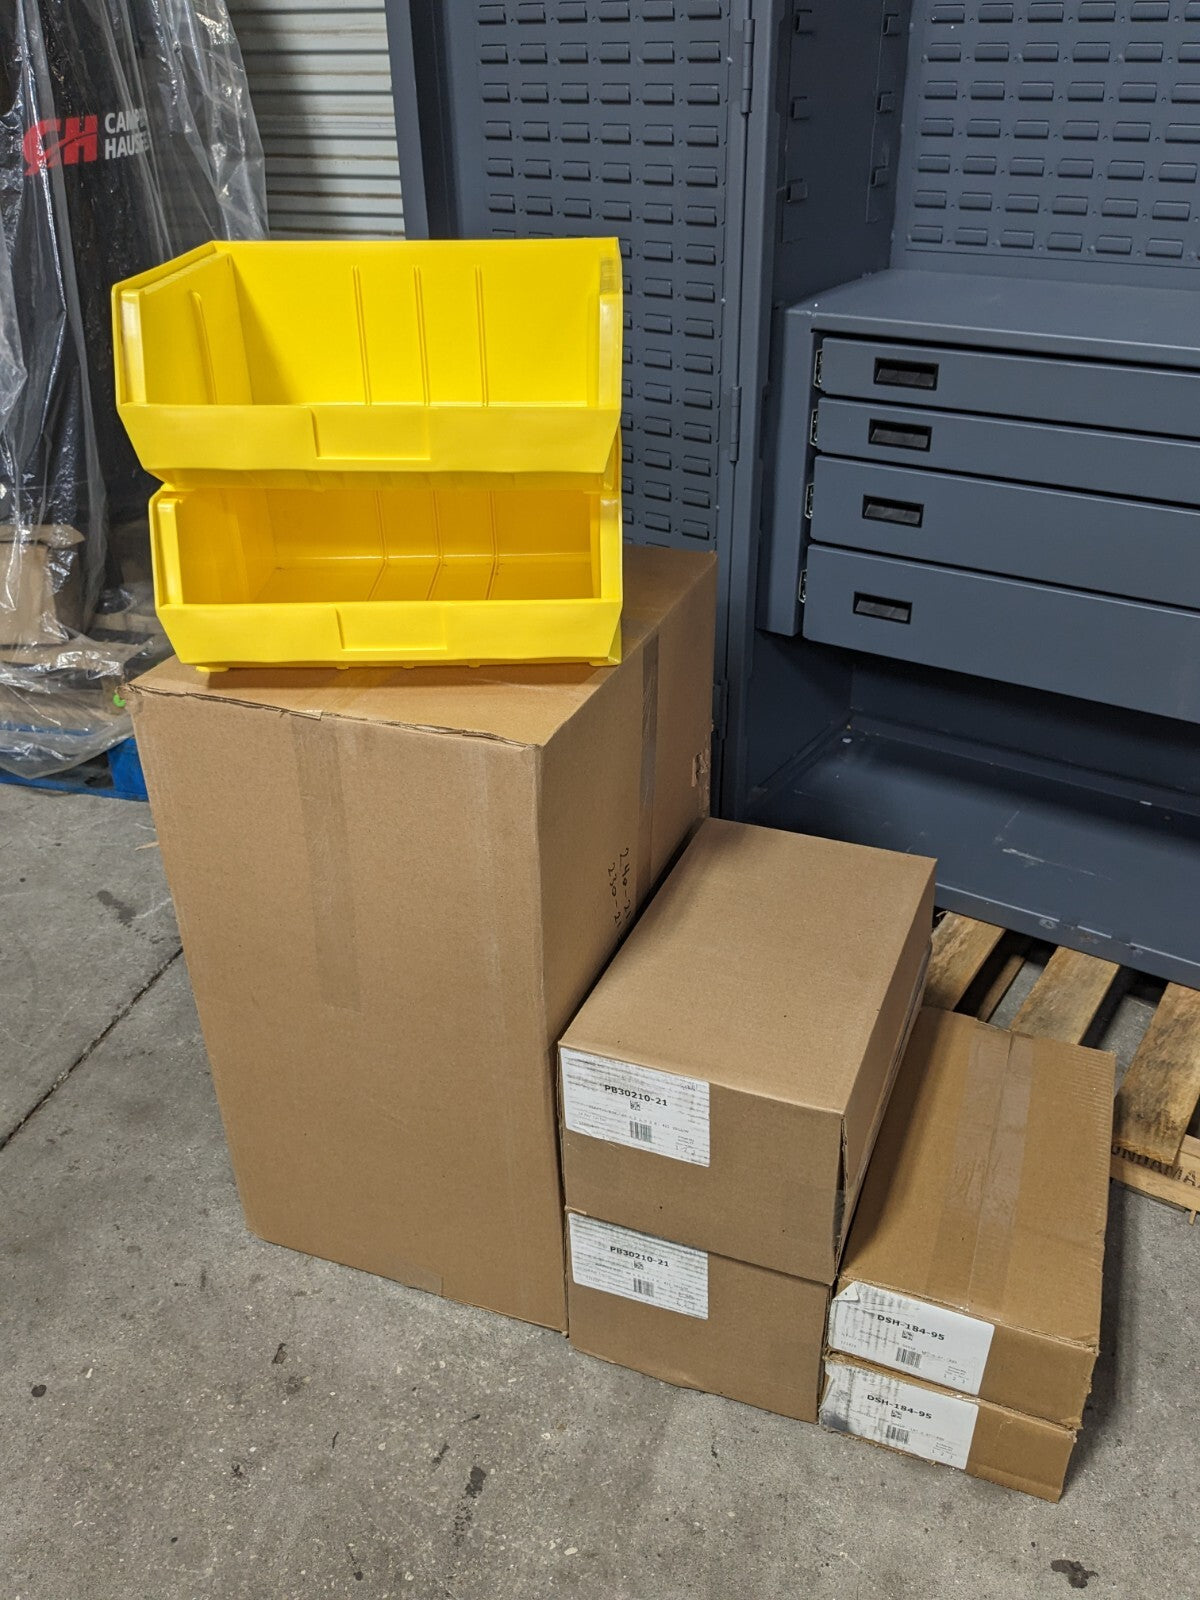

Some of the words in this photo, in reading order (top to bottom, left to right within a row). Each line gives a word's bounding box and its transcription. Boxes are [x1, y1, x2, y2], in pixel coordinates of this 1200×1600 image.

[604, 1084, 668, 1106] PB30210-21
[610, 1246, 669, 1267] PB30210-21
[877, 1314, 945, 1341] DSH-184-95
[867, 1394, 932, 1420] DSH-184-95
